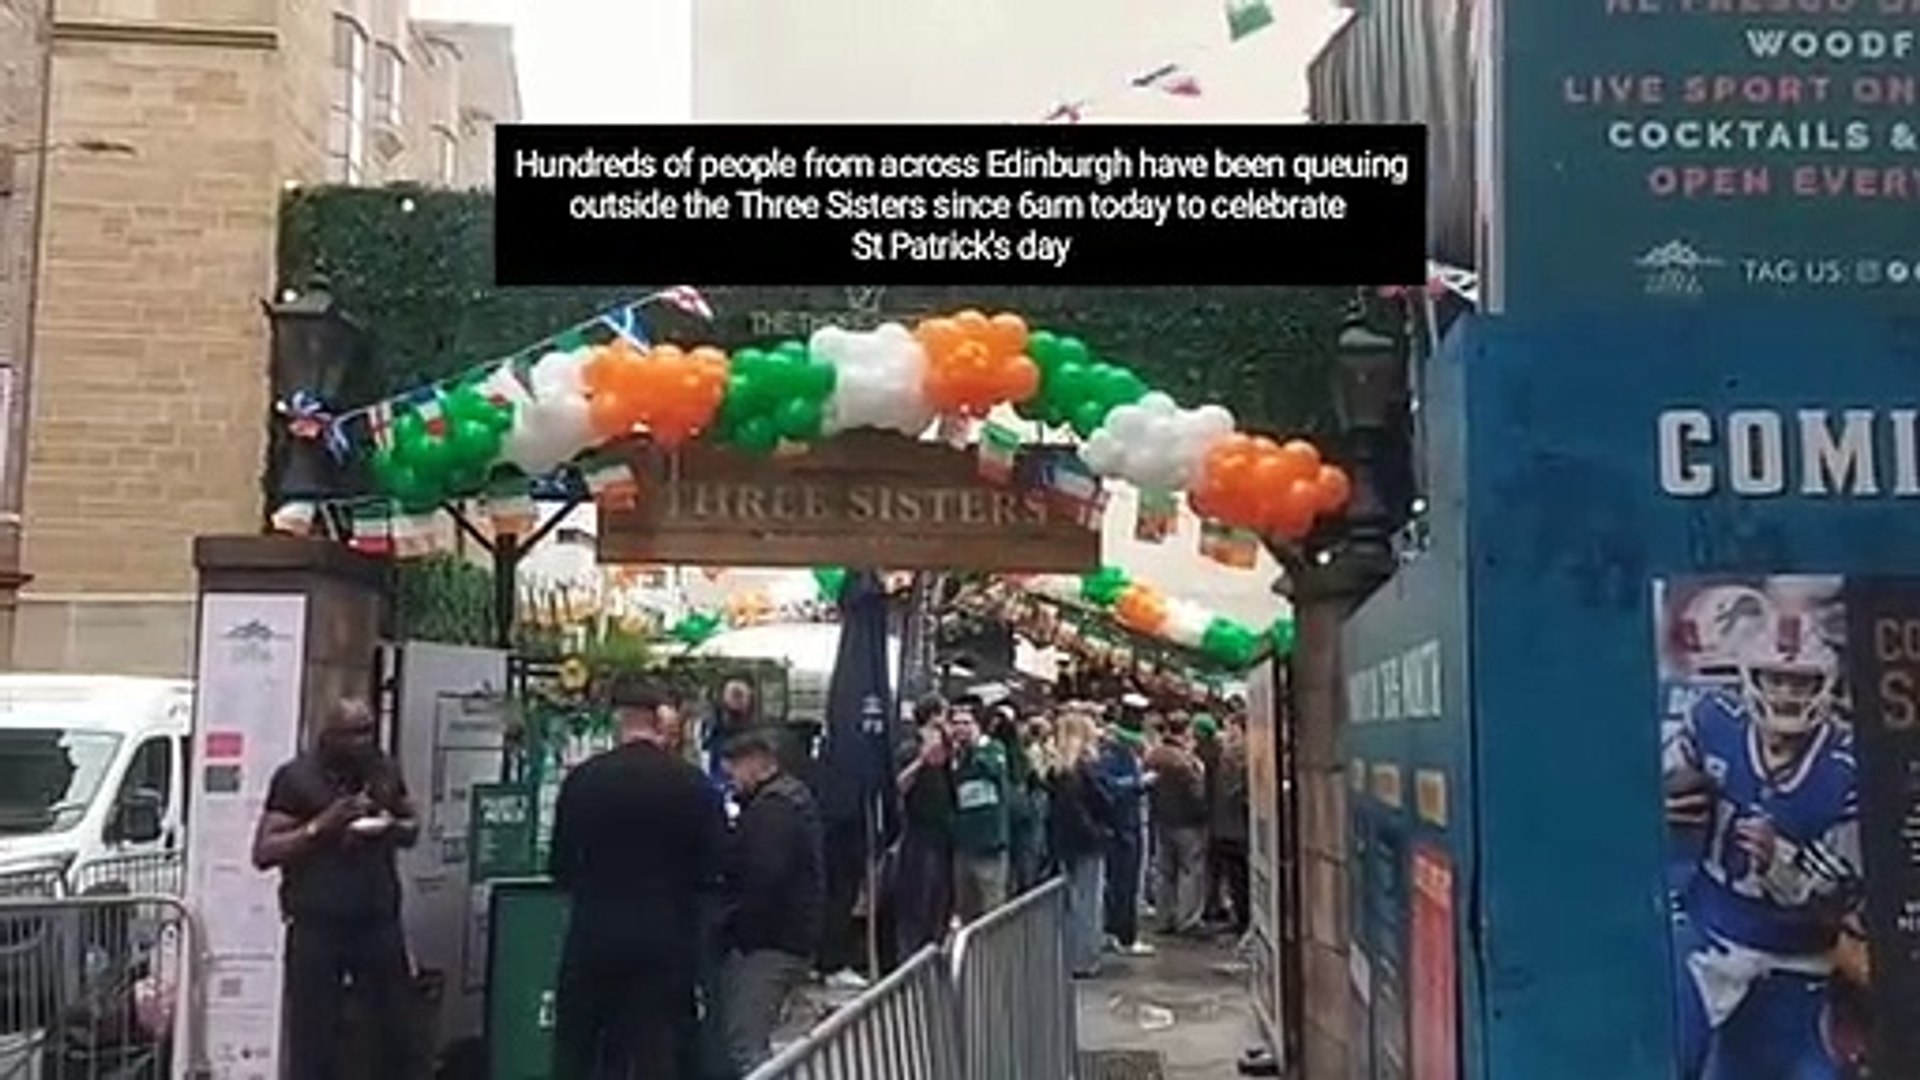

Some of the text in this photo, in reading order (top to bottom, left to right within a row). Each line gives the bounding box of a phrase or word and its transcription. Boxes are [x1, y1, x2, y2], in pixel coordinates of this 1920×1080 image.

[1563, 76, 1916, 103] LIVE SPORT ON
[1608, 121, 1918, 150] COCKTAILS &
[1648, 167, 1769, 195] OPEN
[1742, 259, 1798, 283] TAG
[665, 484, 1050, 525] THREE SISTERS
